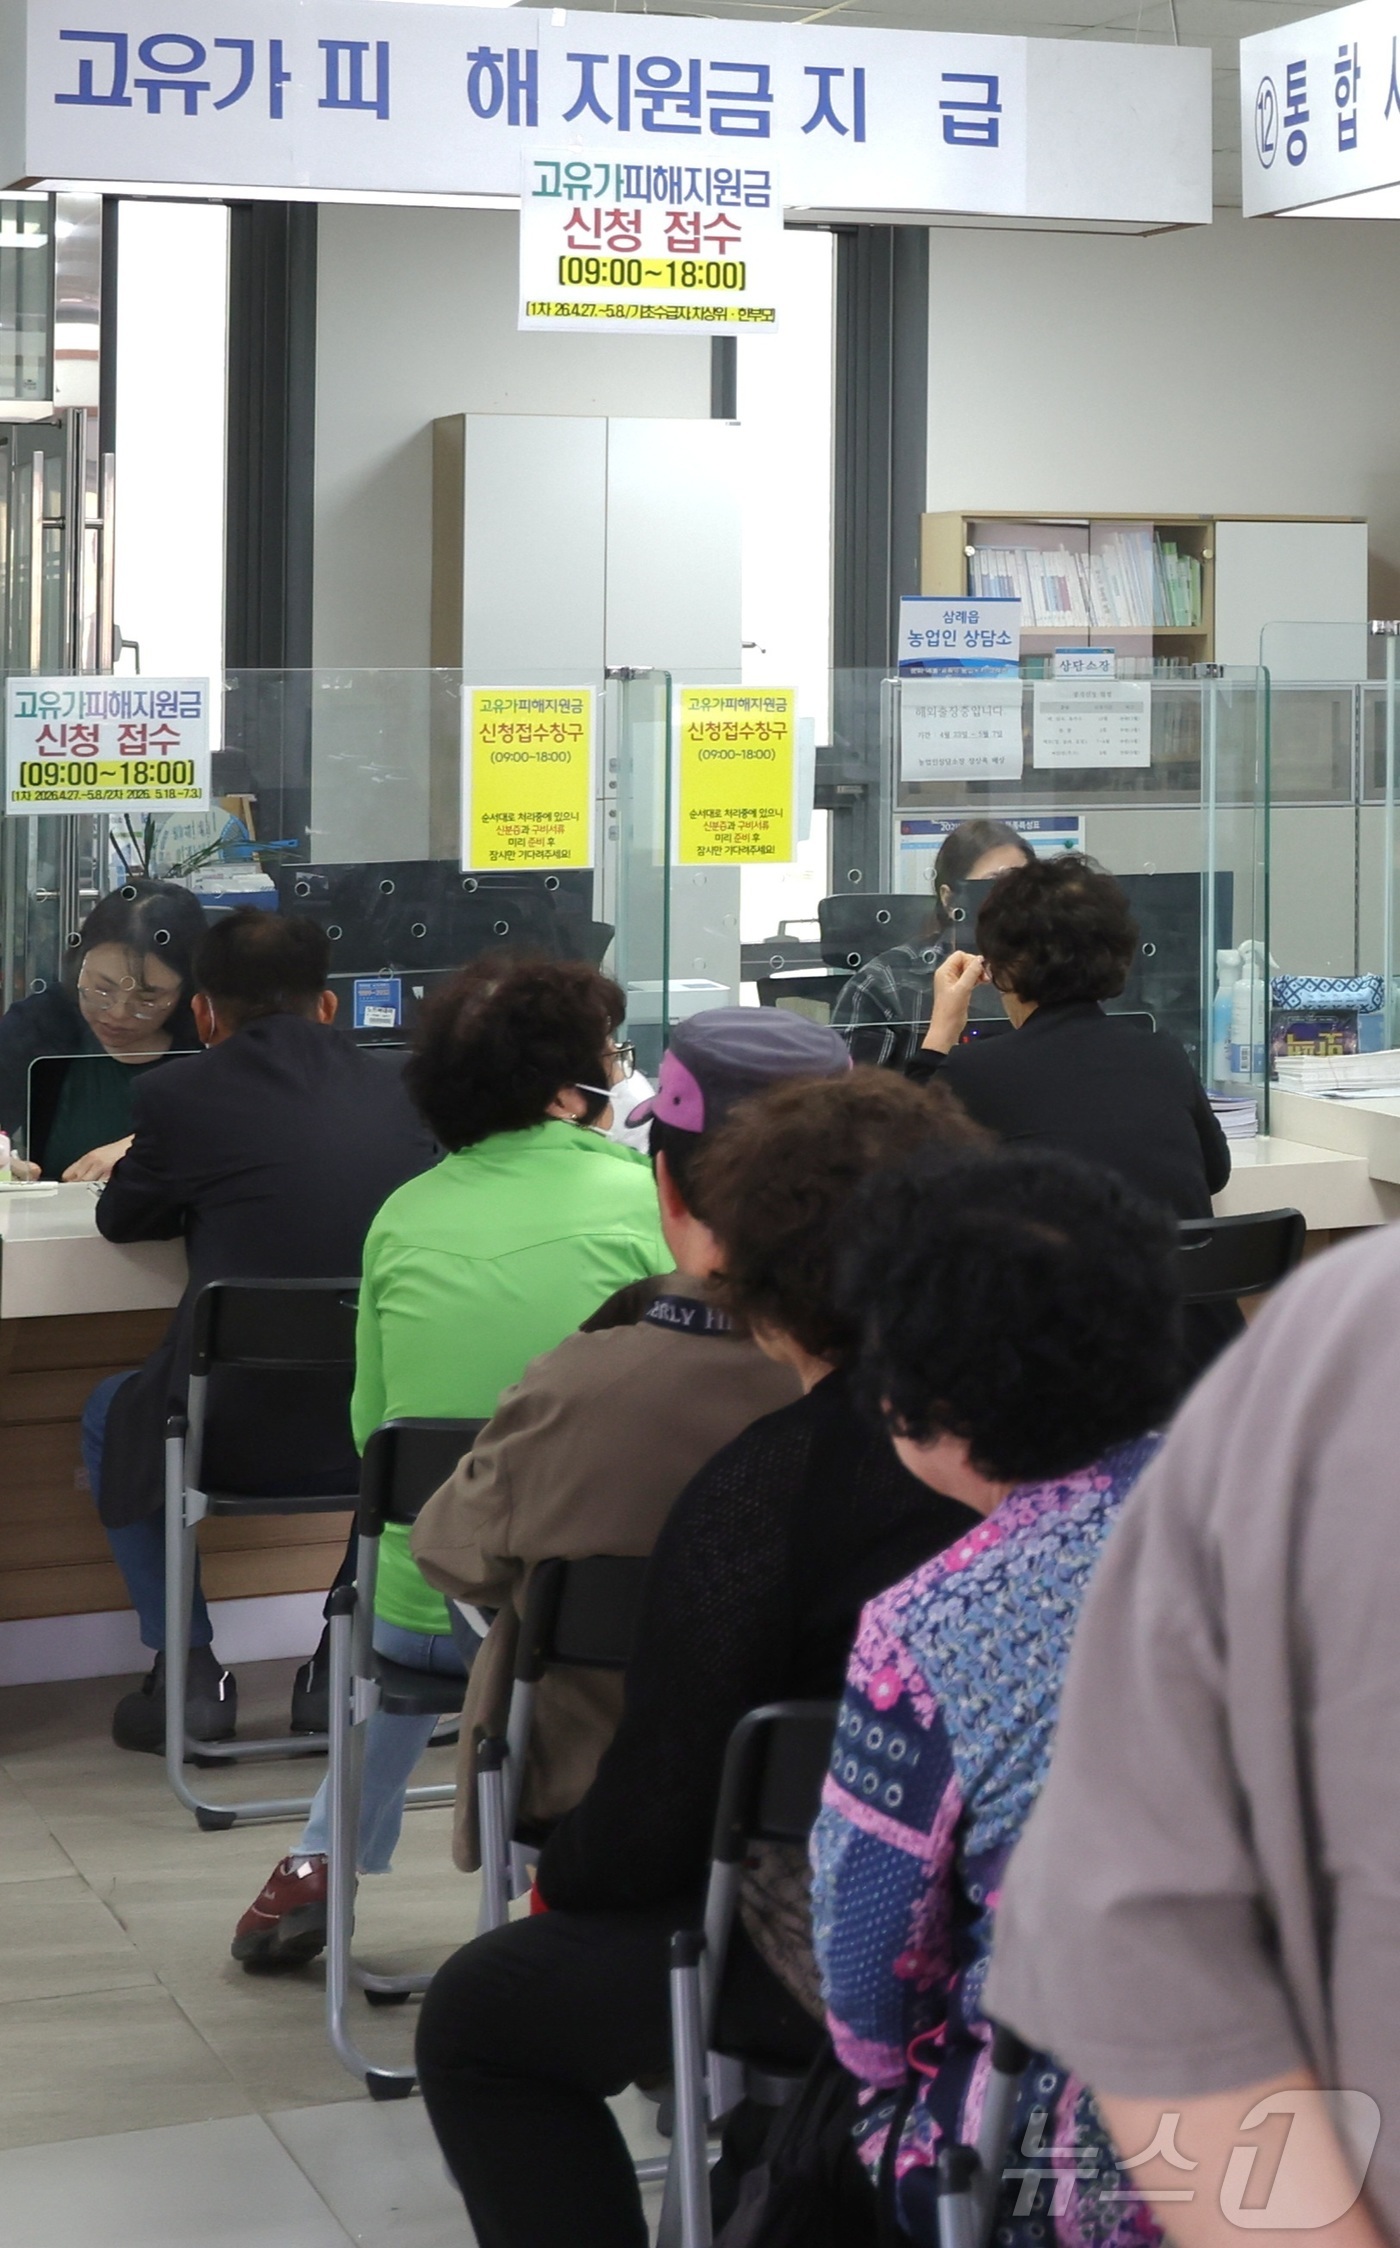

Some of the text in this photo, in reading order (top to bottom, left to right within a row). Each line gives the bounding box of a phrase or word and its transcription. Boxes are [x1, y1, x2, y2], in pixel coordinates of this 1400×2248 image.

[531, 160, 772, 209] 고유가피해지원금
[562, 206, 743, 256] 신청 접수
[942, 609, 980, 625] 삼례읍
[907, 629, 1013, 648] 농업인 상담소
[1059, 659, 1111, 673] 상담소장
[13, 690, 202, 720] 고유가피해지원금
[479, 698, 584, 714] 고유가피해지원금
[687, 697, 788, 713] 고유가피해지원금
[479, 722, 585, 744] 신청접수창구
[687, 721, 788, 742] 신청접수창구
[34, 723, 182, 758] 신청 접수
[489, 751, 572, 765] (09:00~18:00)
[698, 749, 776, 763] (09:00~18:00)
[481, 811, 580, 824] 순서대로 처리중에 있으니
[689, 808, 784, 820] 순서대로 처리중에 있으니
[495, 824, 566, 836] 신분증과 구비서류
[703, 820, 770, 832] 신분증과 구비서류
[507, 837, 556, 848] 미리 준비 후
[714, 832, 761, 844] 미리 준비 후
[488, 849, 572, 862] 잠시만 기다려주세요!
[696, 844, 776, 857] 잠시만 기다려주세요!
